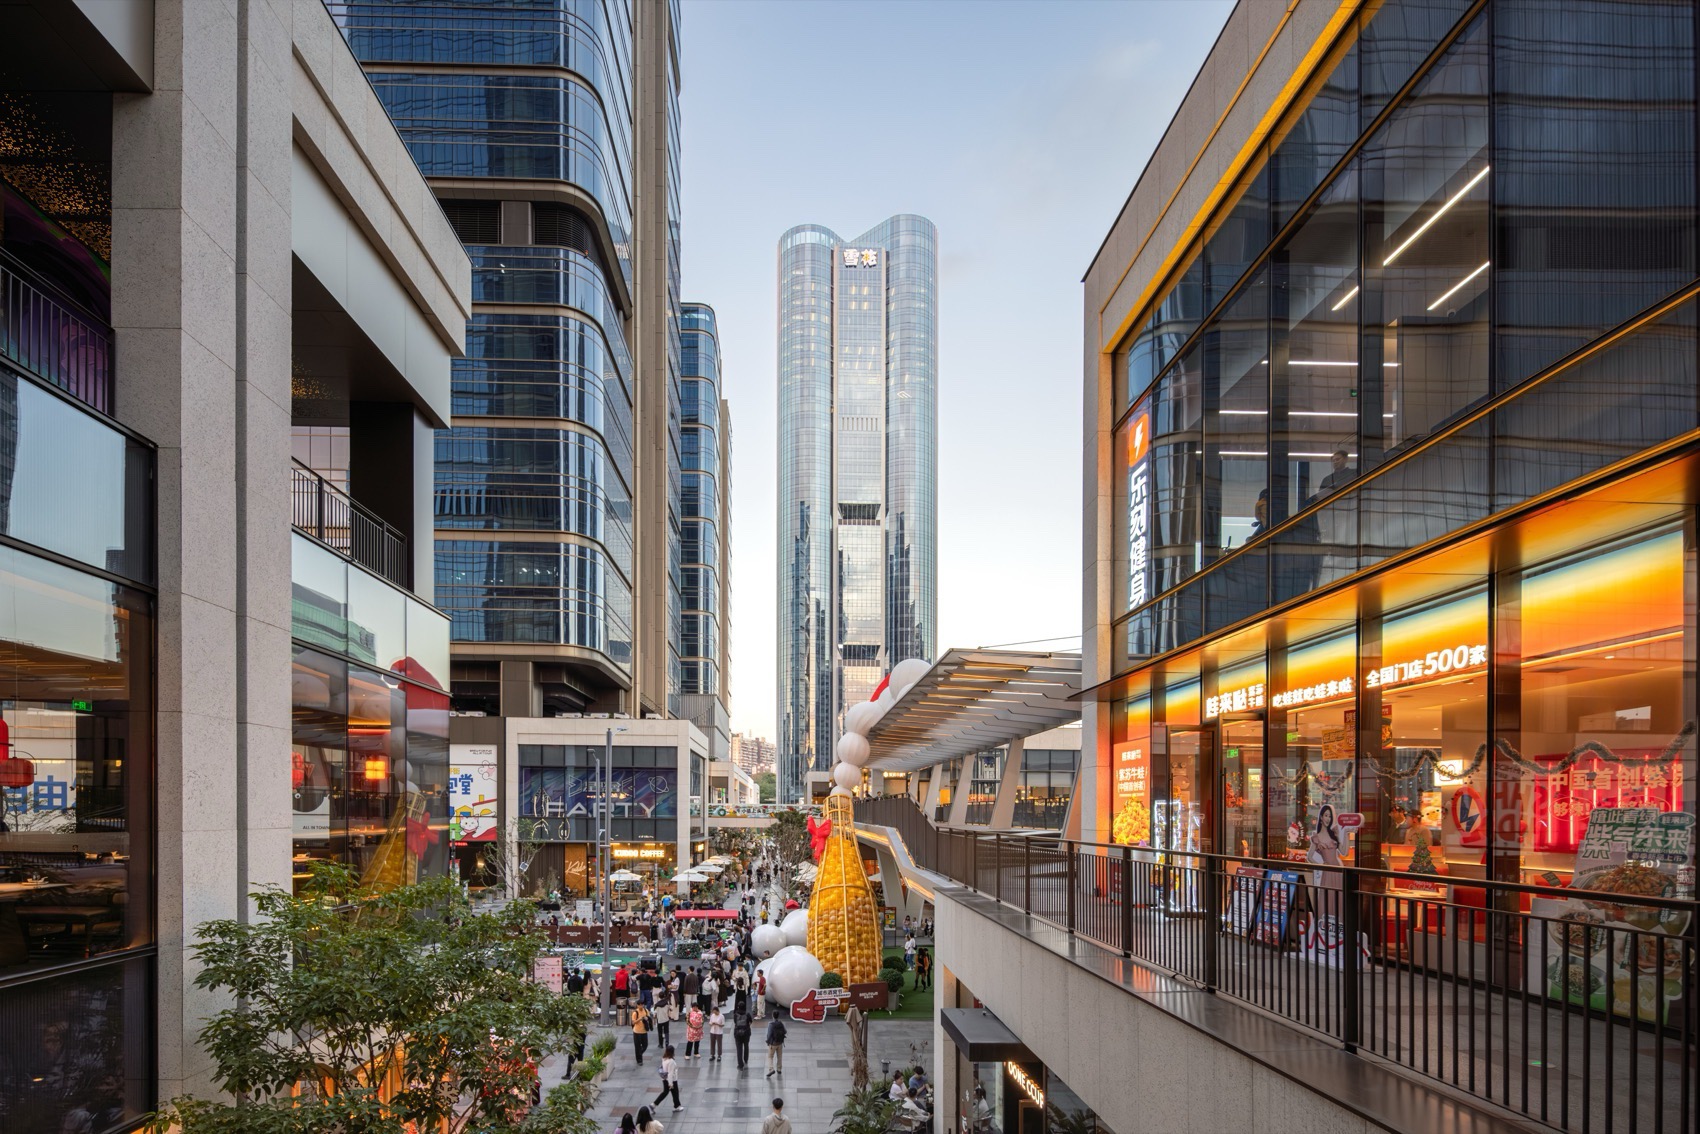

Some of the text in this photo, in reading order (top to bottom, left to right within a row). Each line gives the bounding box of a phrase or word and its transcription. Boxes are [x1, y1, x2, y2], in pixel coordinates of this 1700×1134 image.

[843, 248, 878, 267] 雪花
[1129, 461, 1147, 610] 乐刻健身
[1366, 644, 1487, 689] 全国门店500家
[1582, 824, 1688, 860] 紫气东来
